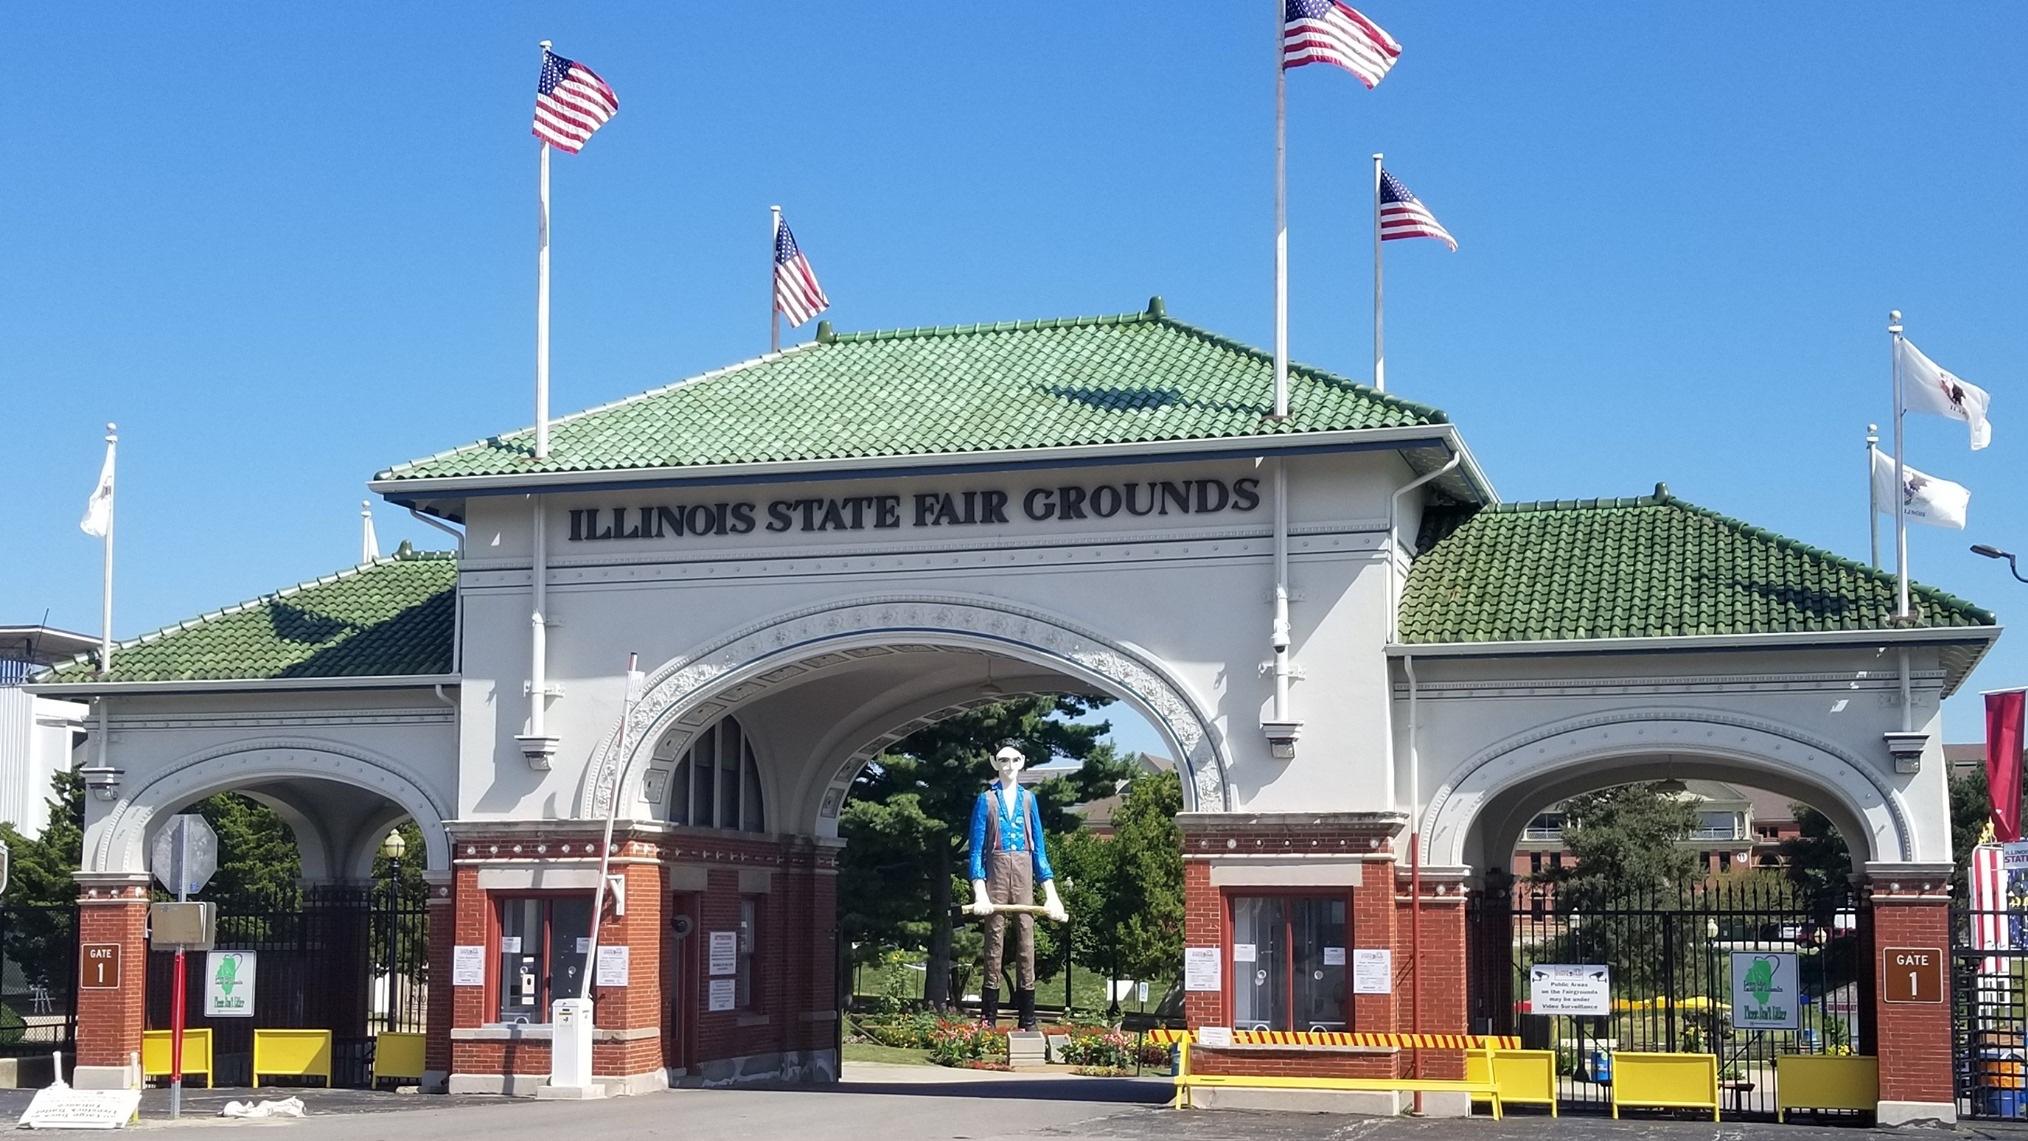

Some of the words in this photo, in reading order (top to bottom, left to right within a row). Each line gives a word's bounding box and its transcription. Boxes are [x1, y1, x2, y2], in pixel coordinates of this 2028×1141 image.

[569, 502, 756, 542] ILLINOIS
[766, 495, 901, 532] STATE
[912, 491, 1009, 527] FAIR
[1022, 478, 1261, 522] GROUNDS
[90, 949, 112, 958] GATE
[1896, 954, 1929, 966] GATE
[97, 962, 104, 983] 1
[1909, 971, 1917, 996] 1
